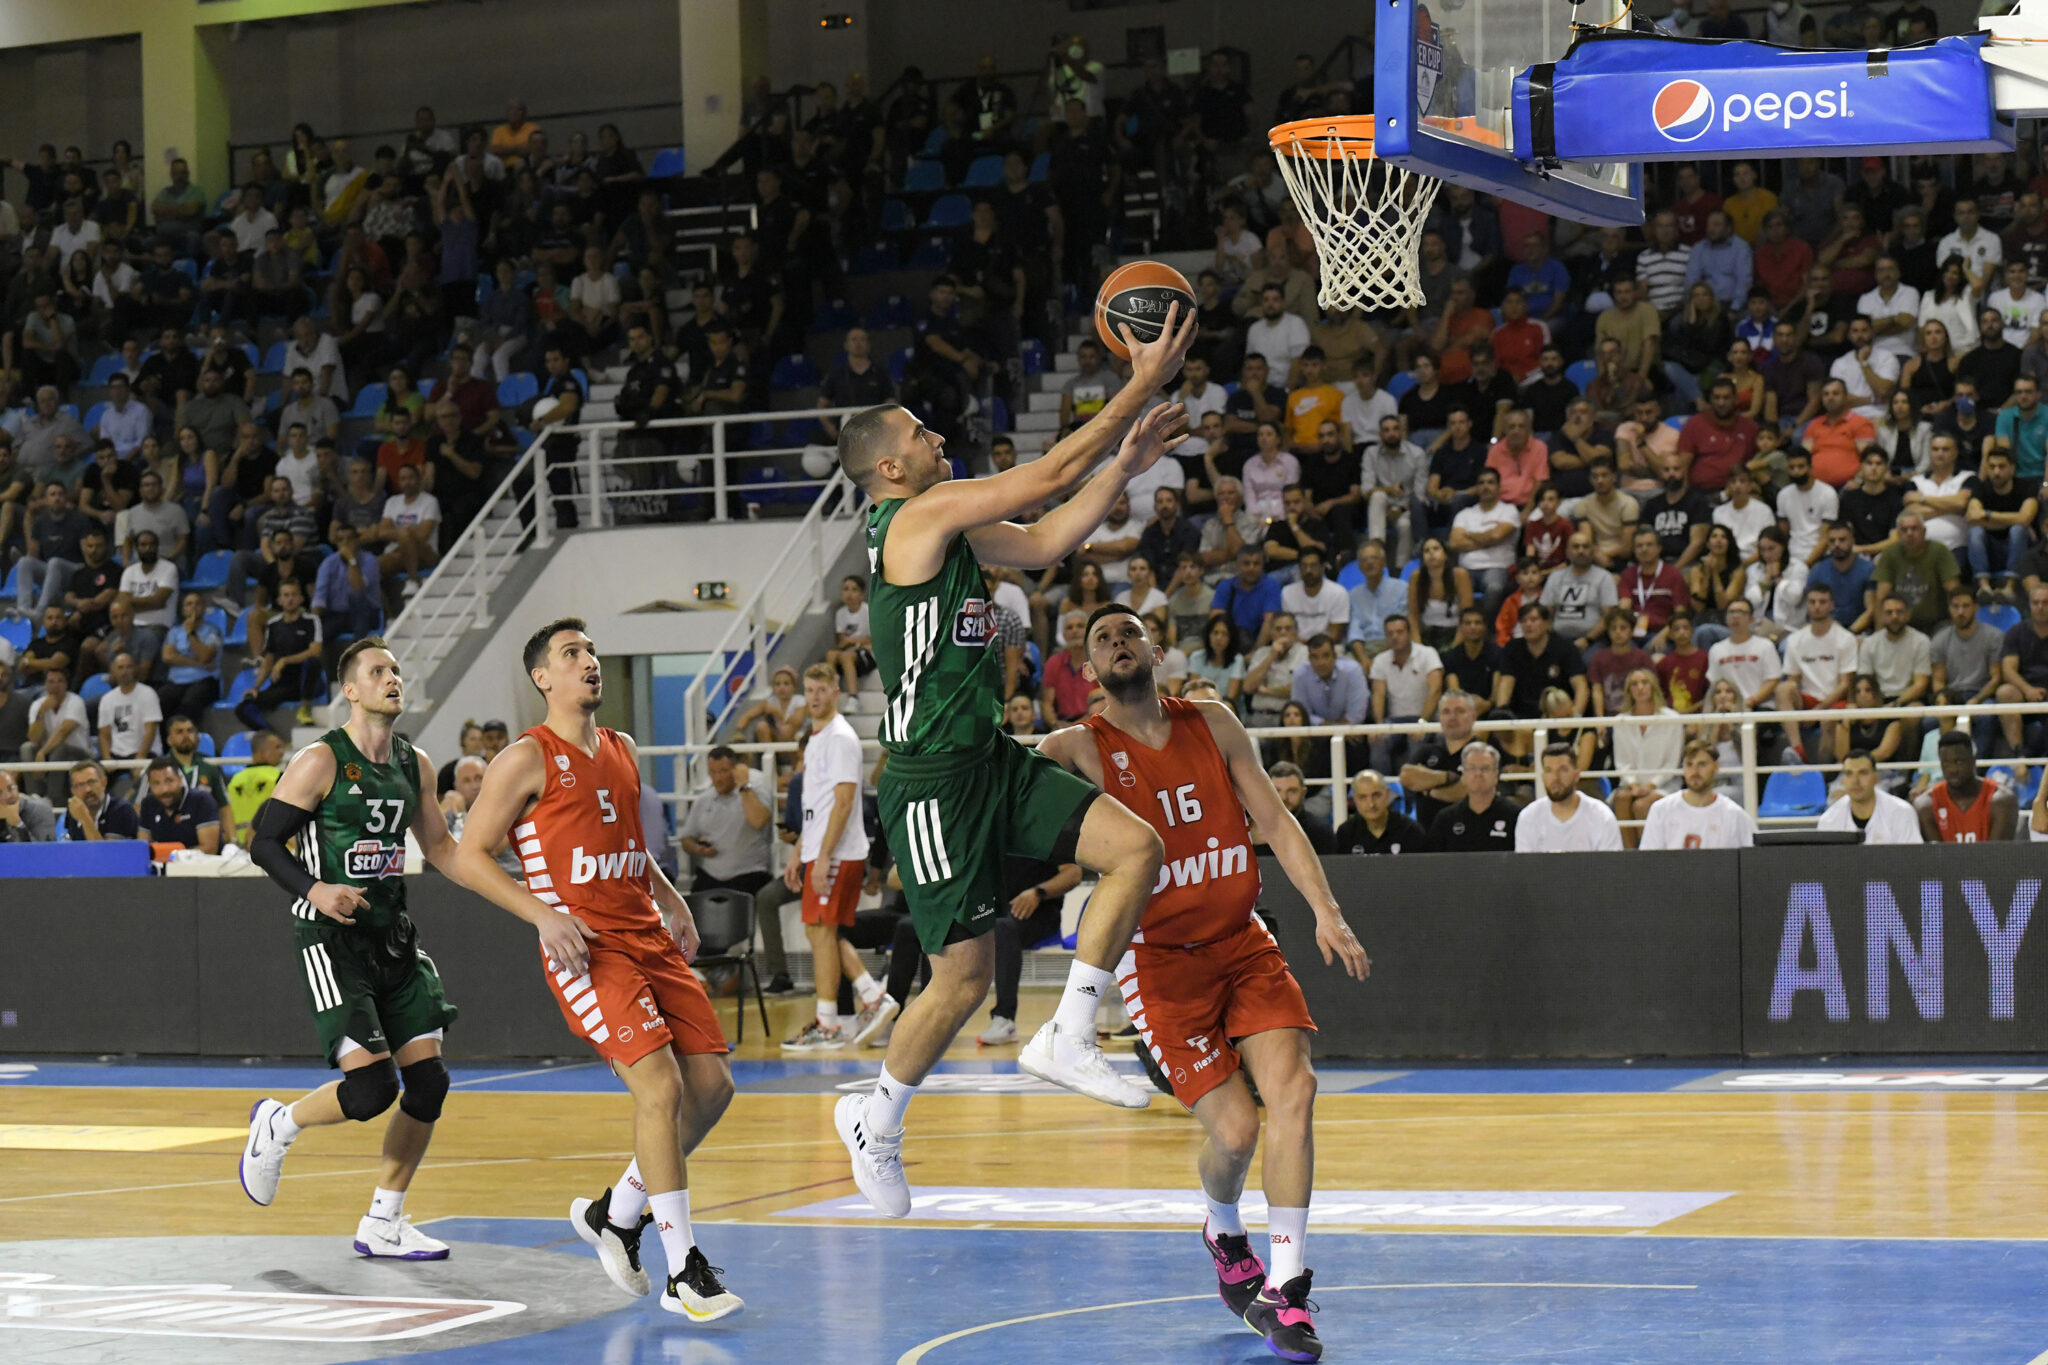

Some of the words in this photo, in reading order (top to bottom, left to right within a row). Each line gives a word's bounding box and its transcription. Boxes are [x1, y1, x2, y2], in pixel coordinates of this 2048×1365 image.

[1427, 47, 1440, 70] CUP
[1723, 81, 1848, 132] pepsi
[365, 799, 405, 833] 37
[596, 789, 618, 823] 5
[1156, 783, 1203, 828] 16
[570, 838, 647, 884] bwin
[1767, 878, 2043, 1023] ANY
